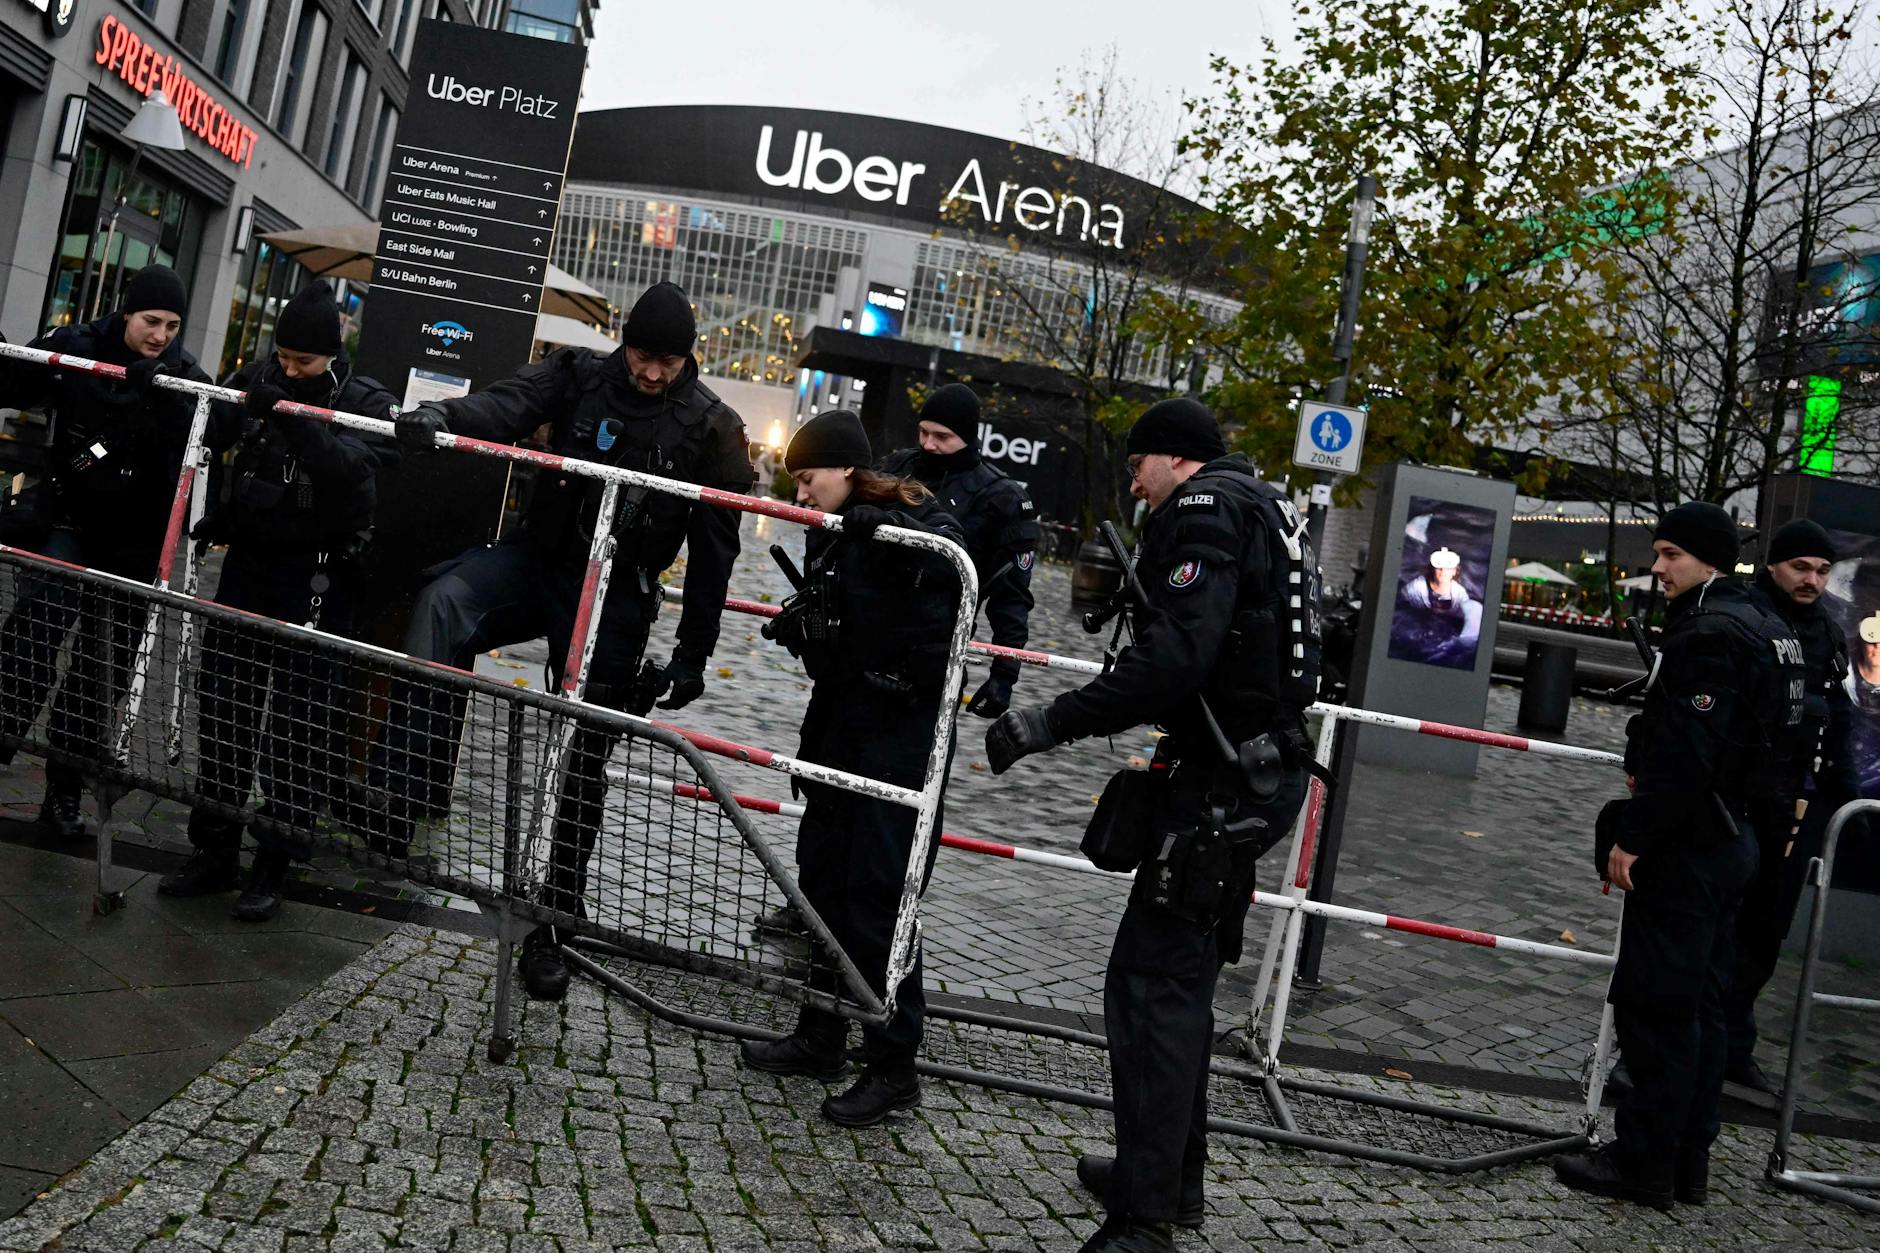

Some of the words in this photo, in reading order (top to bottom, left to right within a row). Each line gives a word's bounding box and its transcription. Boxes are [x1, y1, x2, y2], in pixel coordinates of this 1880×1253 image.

[427, 73, 495, 107] Uber
[499, 86, 559, 119] Platz
[403, 156, 428, 168] Uber
[428, 160, 460, 175] Arena
[464, 171, 490, 180] Premium
[397, 183, 423, 197] Uber
[423, 188, 445, 201] Eats
[446, 192, 476, 206] Music
[477, 199, 497, 210] Hall
[755, 125, 926, 206] Uber
[938, 157, 1125, 250] Arena
[391, 211, 411, 223] UCI
[412, 218, 431, 227] LUXE
[437, 220, 477, 237] Bowling
[386, 239, 408, 252] East
[408, 243, 432, 257] Side
[433, 248, 455, 261] Mall
[381, 268, 400, 279] S/U
[401, 272, 427, 284] Bahn
[428, 277, 457, 290] Berlin
[421, 324, 445, 336] Free
[447, 328, 473, 342] Wi-Fi
[426, 347, 443, 356] Uber
[1311, 452, 1343, 467] ZONE
[1178, 494, 1214, 508] POLIZEI
